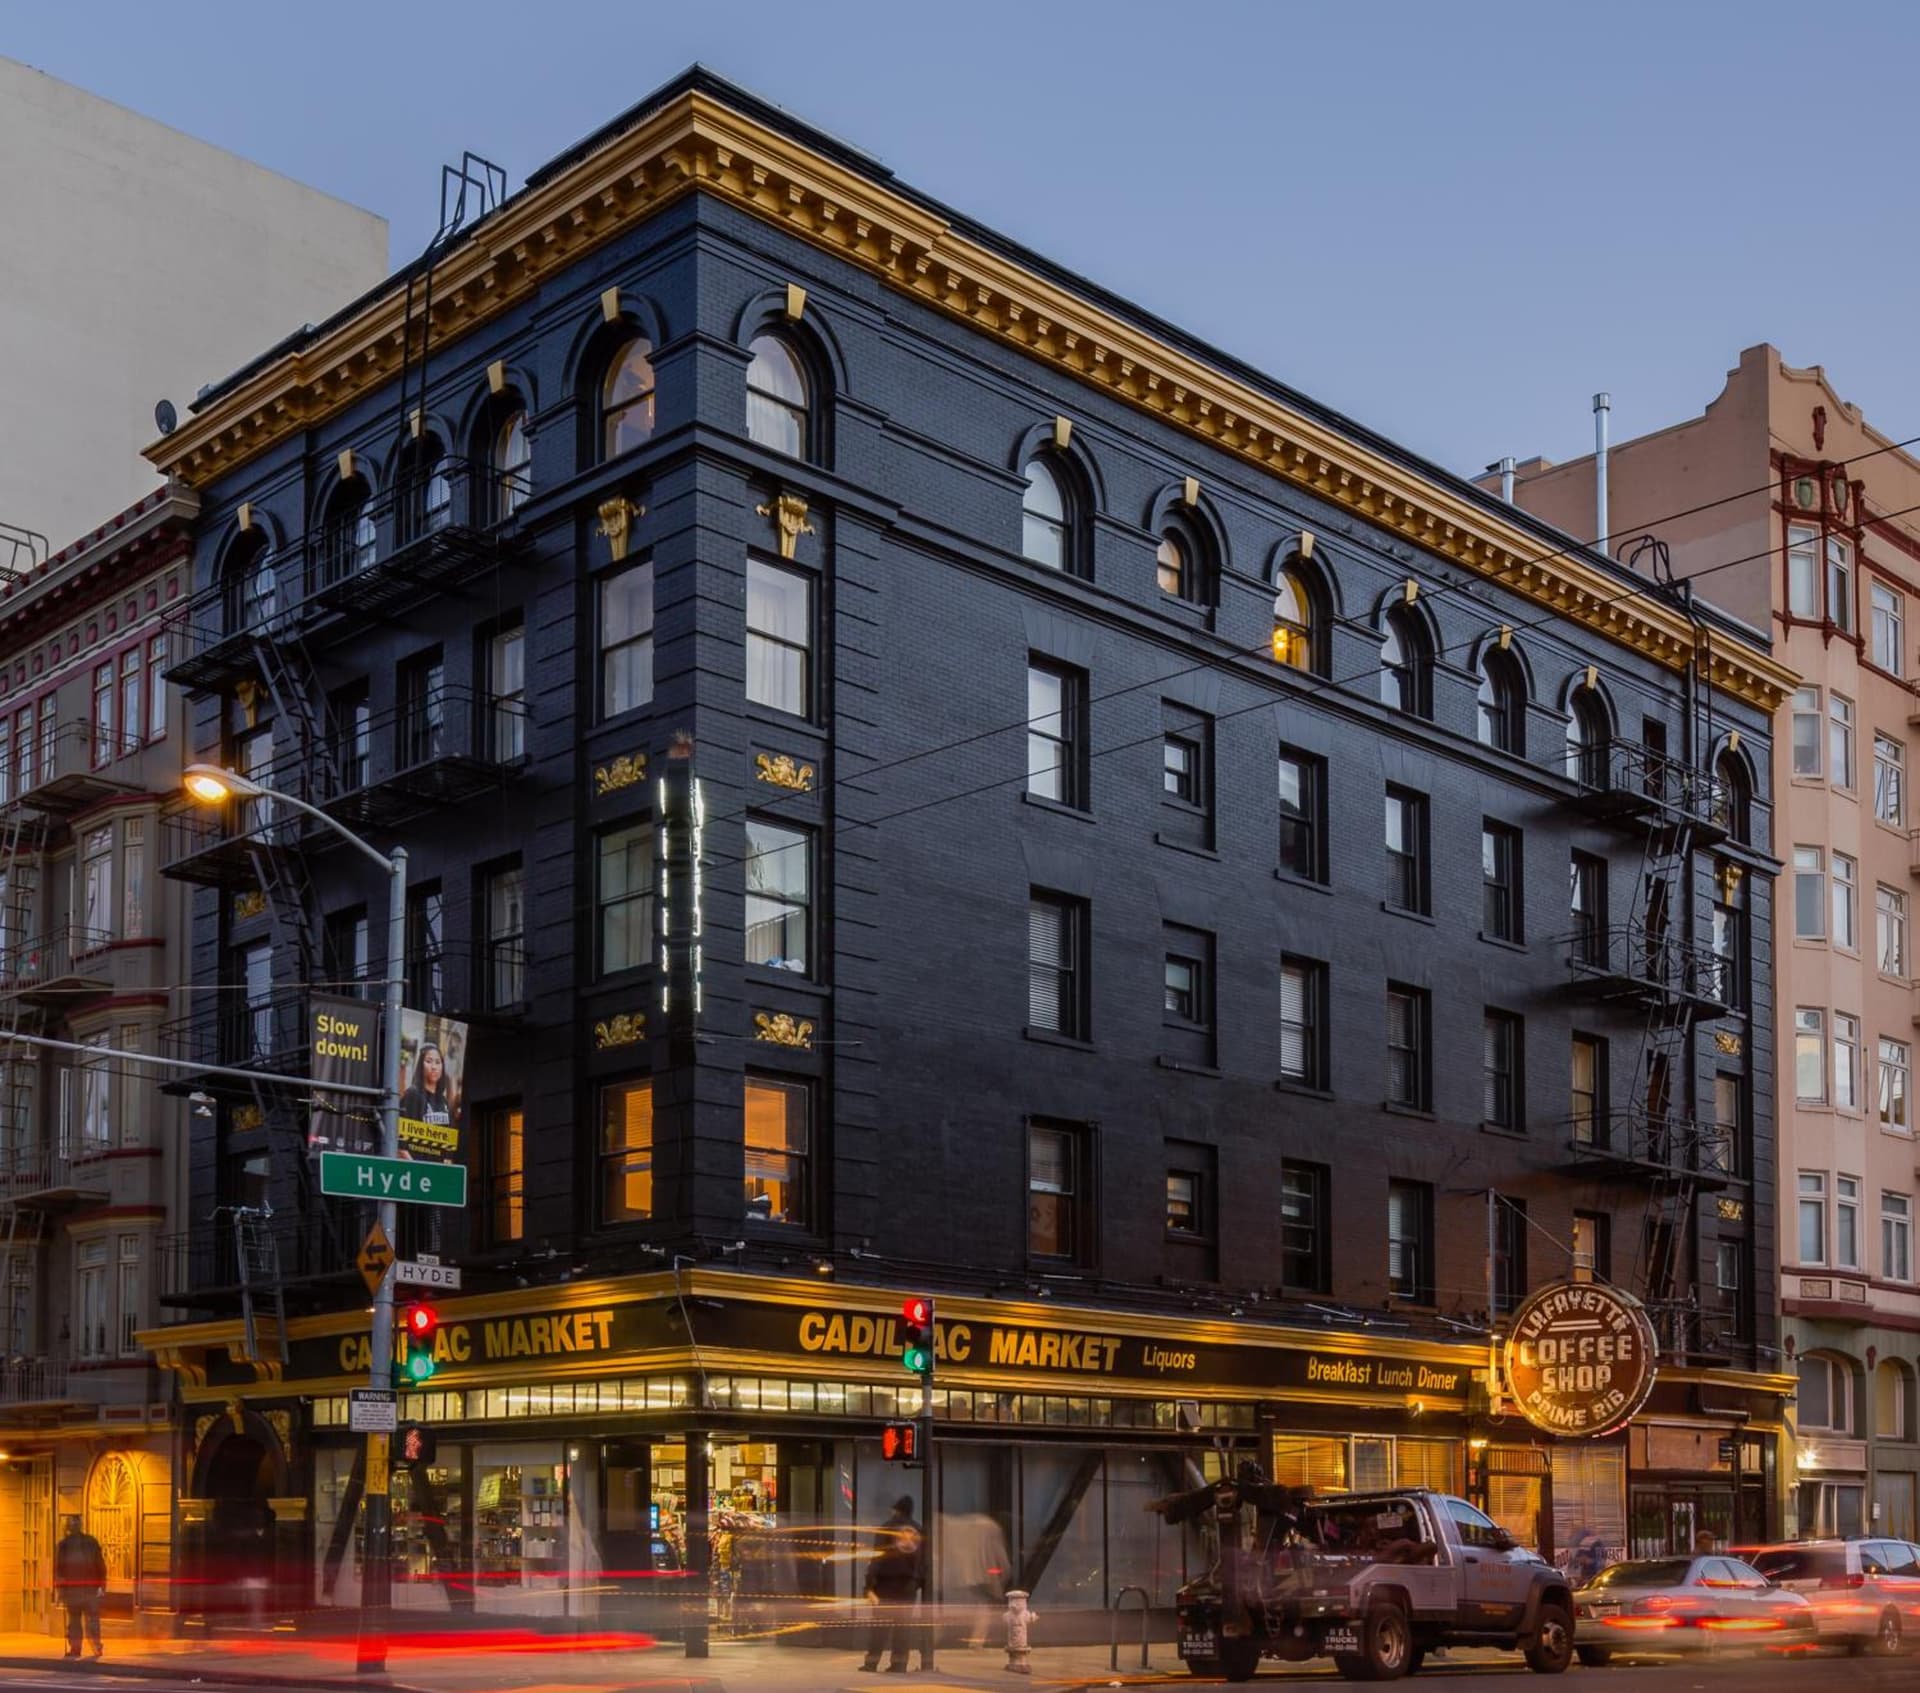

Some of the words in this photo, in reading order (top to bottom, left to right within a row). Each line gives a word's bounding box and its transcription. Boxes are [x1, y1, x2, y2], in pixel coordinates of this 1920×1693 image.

[317, 1014, 359, 1038] Slow
[316, 1038, 369, 1061] down!
[407, 1122, 424, 1136] live
[426, 1126, 449, 1142] here
[357, 1165, 432, 1193] Hyde
[403, 1265, 454, 1285] HYDE
[1520, 1290, 1631, 1338] LAFAYETTE
[484, 1310, 614, 1359] MARKET
[799, 1312, 971, 1361] CADILAC
[990, 1328, 1122, 1371] MARKET
[1142, 1346, 1196, 1372] Liquors
[1520, 1335, 1632, 1367] COFFEE
[1307, 1356, 1371, 1384] Breakfast
[1377, 1361, 1412, 1387] Lunch
[1417, 1366, 1457, 1390] Dinner
[1542, 1365, 1611, 1393] SHOP
[1527, 1390, 1586, 1426] PRIME
[1592, 1388, 1624, 1420] RIB
